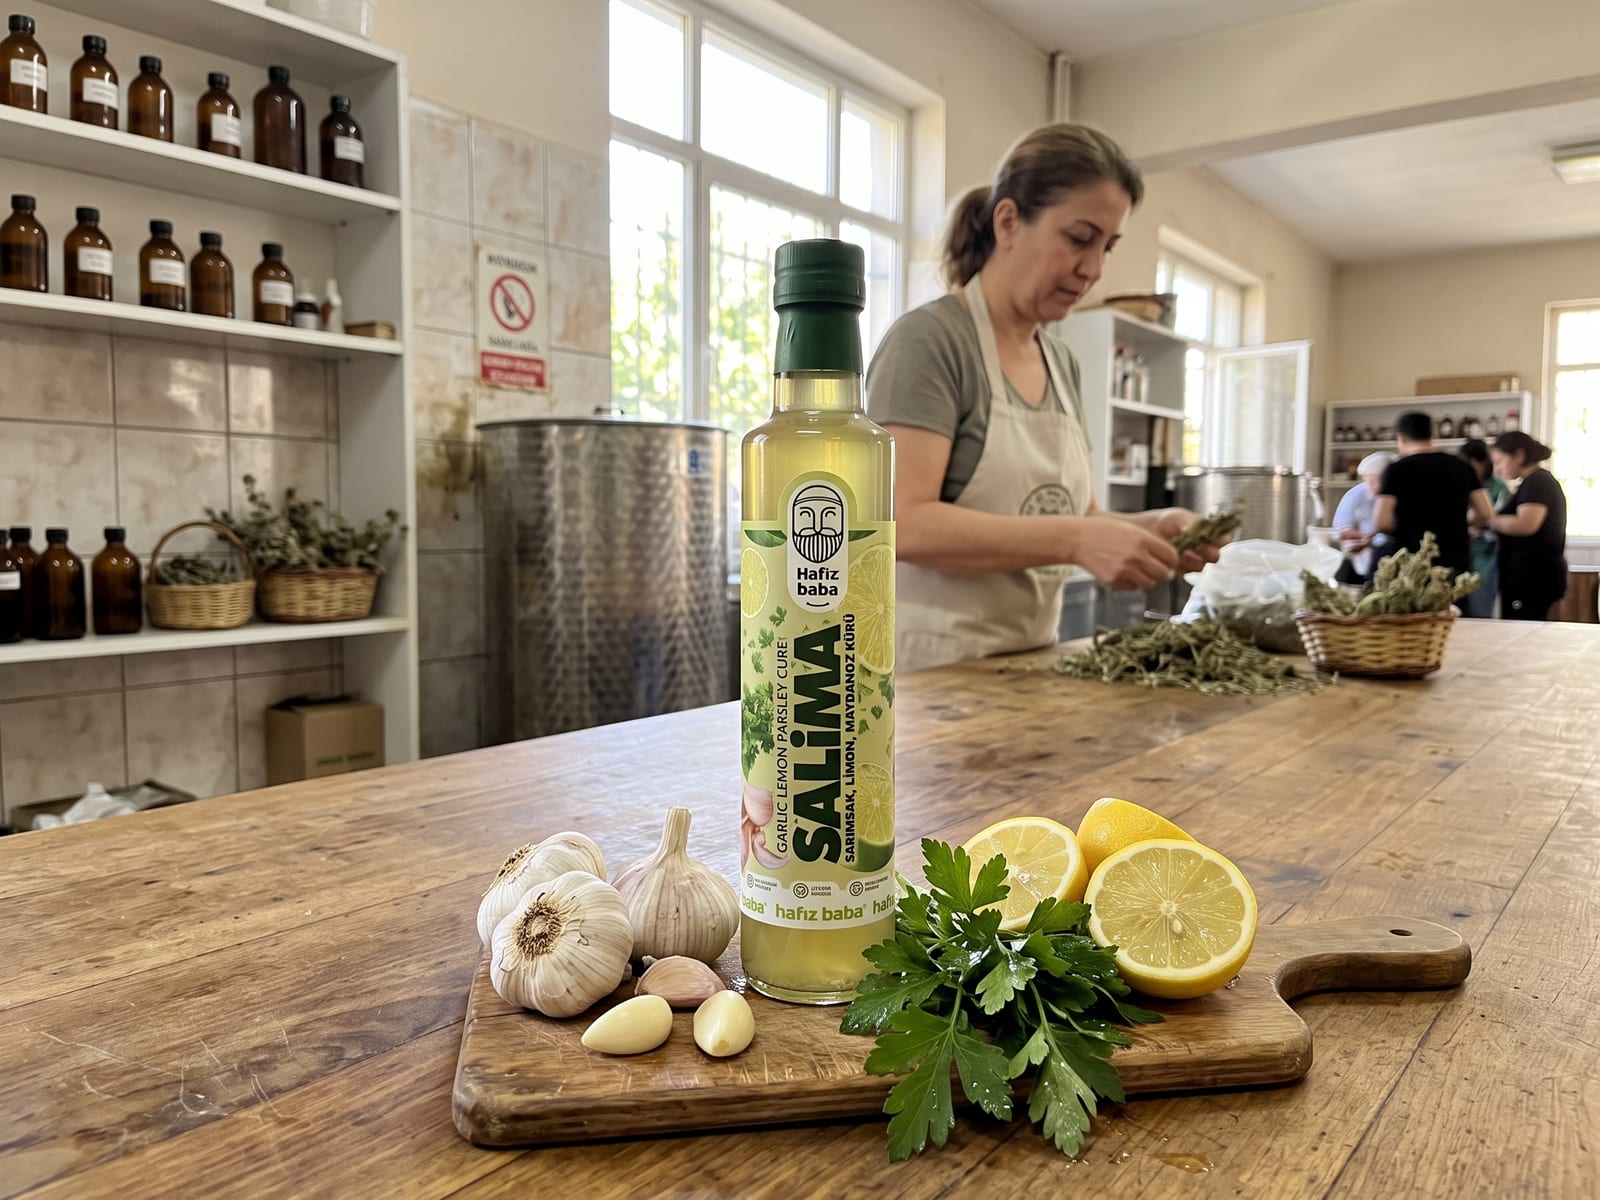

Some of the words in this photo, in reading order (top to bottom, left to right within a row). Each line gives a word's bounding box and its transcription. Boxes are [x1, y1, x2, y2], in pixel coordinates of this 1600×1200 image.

[797, 567, 839, 580] Hafiz
[797, 582, 838, 596] baba
[842, 613, 856, 651] KÜRÜ
[777, 641, 788, 679] CURE
[777, 683, 788, 742] PARSLEY
[845, 653, 856, 732] MAYDANOZ
[777, 747, 788, 798] LEMON
[777, 803, 788, 853] GARLIC
[845, 789, 857, 863] SARIMSAK,
[822, 906, 863, 921] baba
